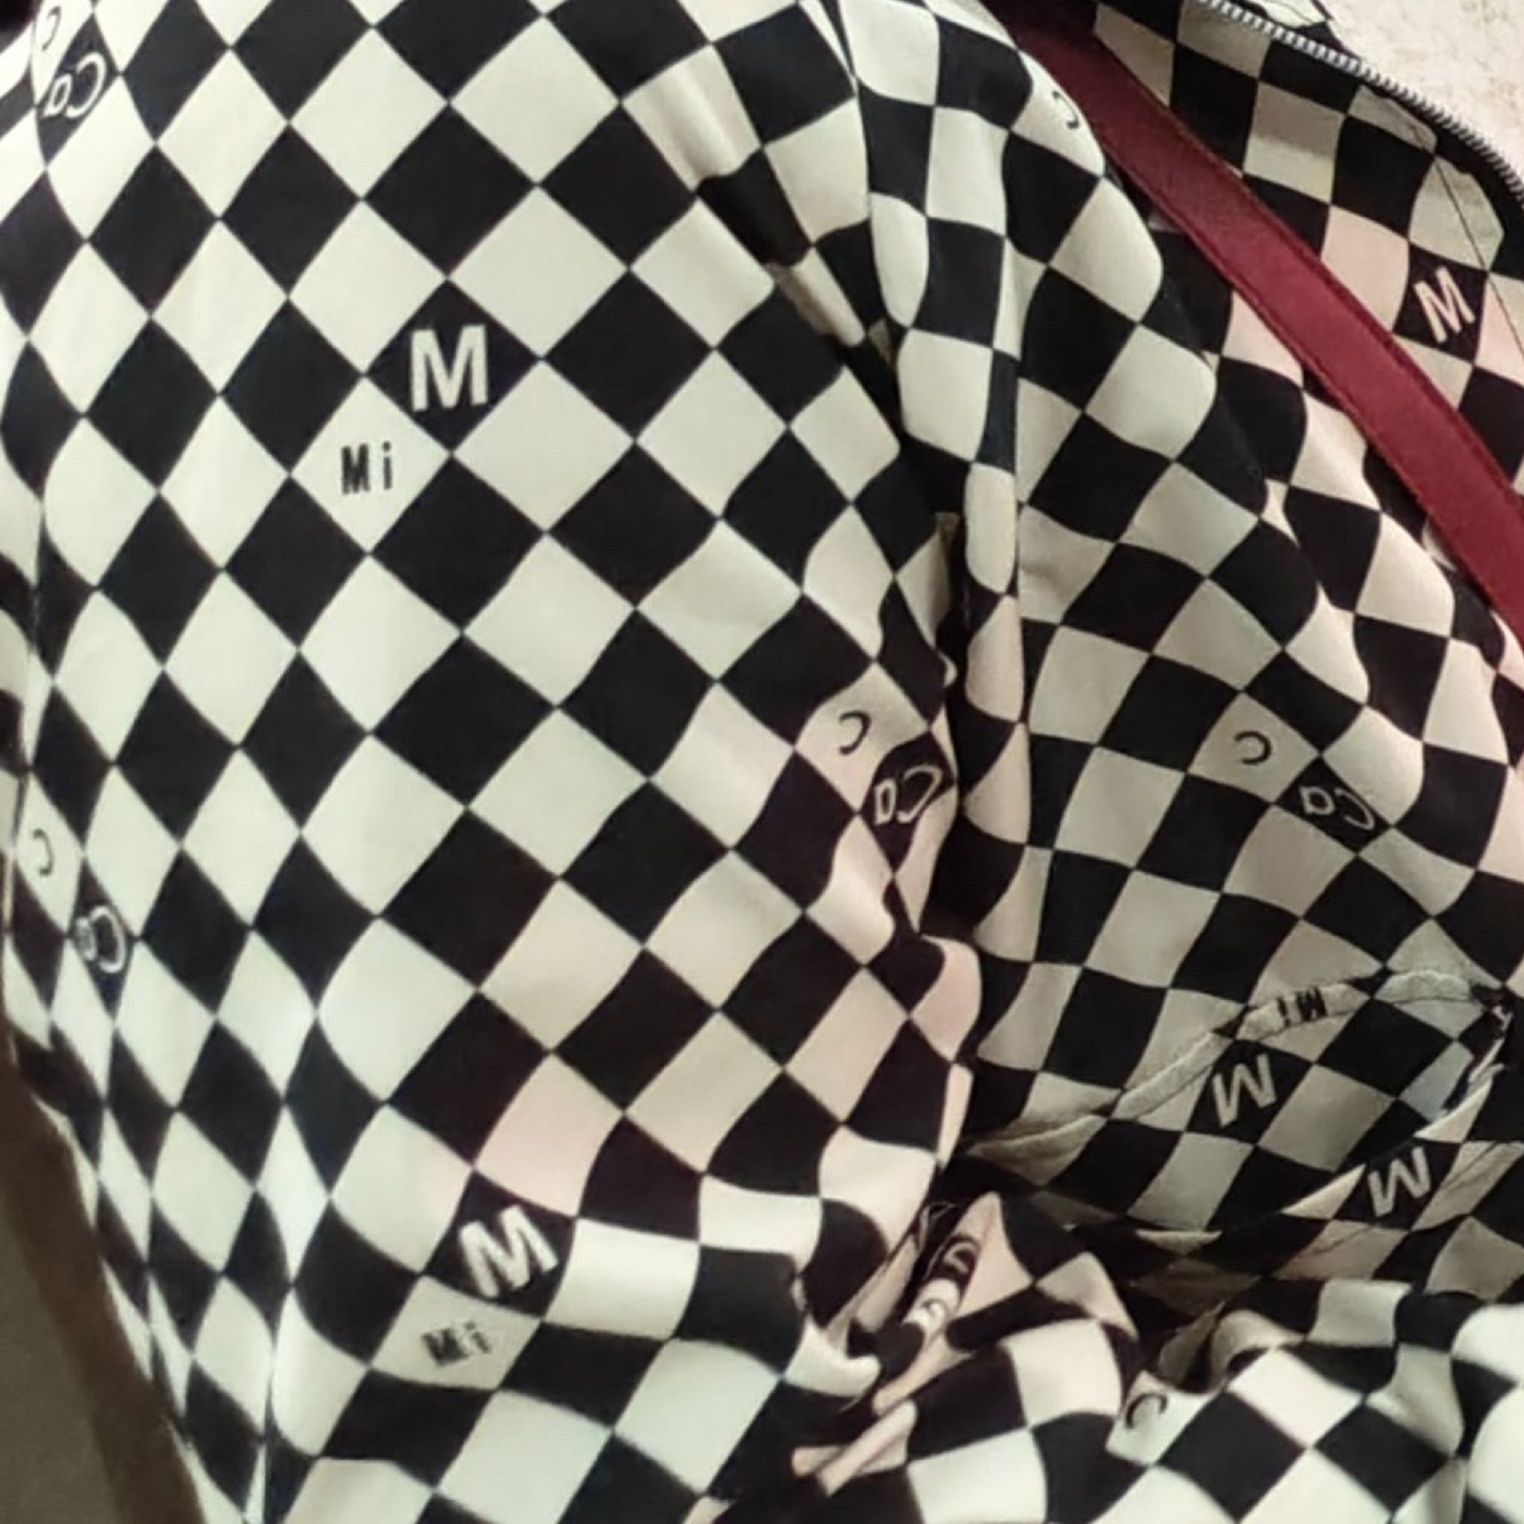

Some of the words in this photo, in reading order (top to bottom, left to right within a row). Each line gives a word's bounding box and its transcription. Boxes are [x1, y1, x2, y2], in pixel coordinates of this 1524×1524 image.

[409, 324, 489, 412] M
[340, 440, 393, 496] Mi
[459, 1205, 558, 1299] M
